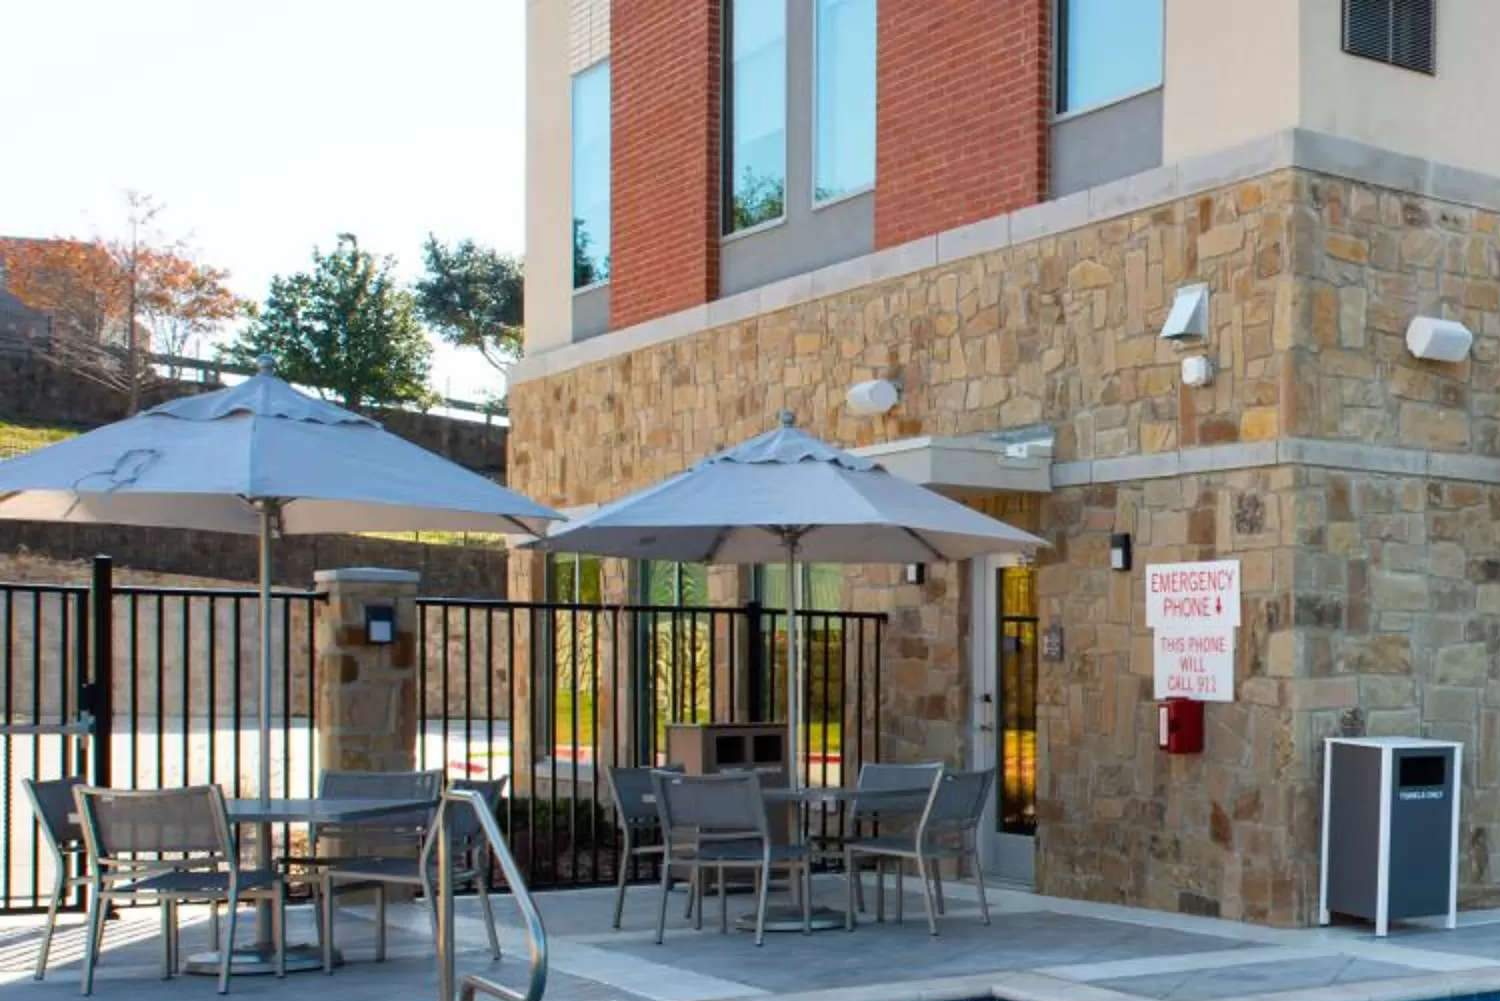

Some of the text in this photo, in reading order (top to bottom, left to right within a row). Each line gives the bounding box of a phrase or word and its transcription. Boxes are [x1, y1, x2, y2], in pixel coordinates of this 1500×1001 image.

[1151, 570, 1235, 594] EMERGENCY
[1163, 597, 1212, 618] PHONE
[1160, 636, 1227, 654] THIS PHONE
[1179, 656, 1207, 673] WILL
[1167, 675, 1217, 693] CALL 911
